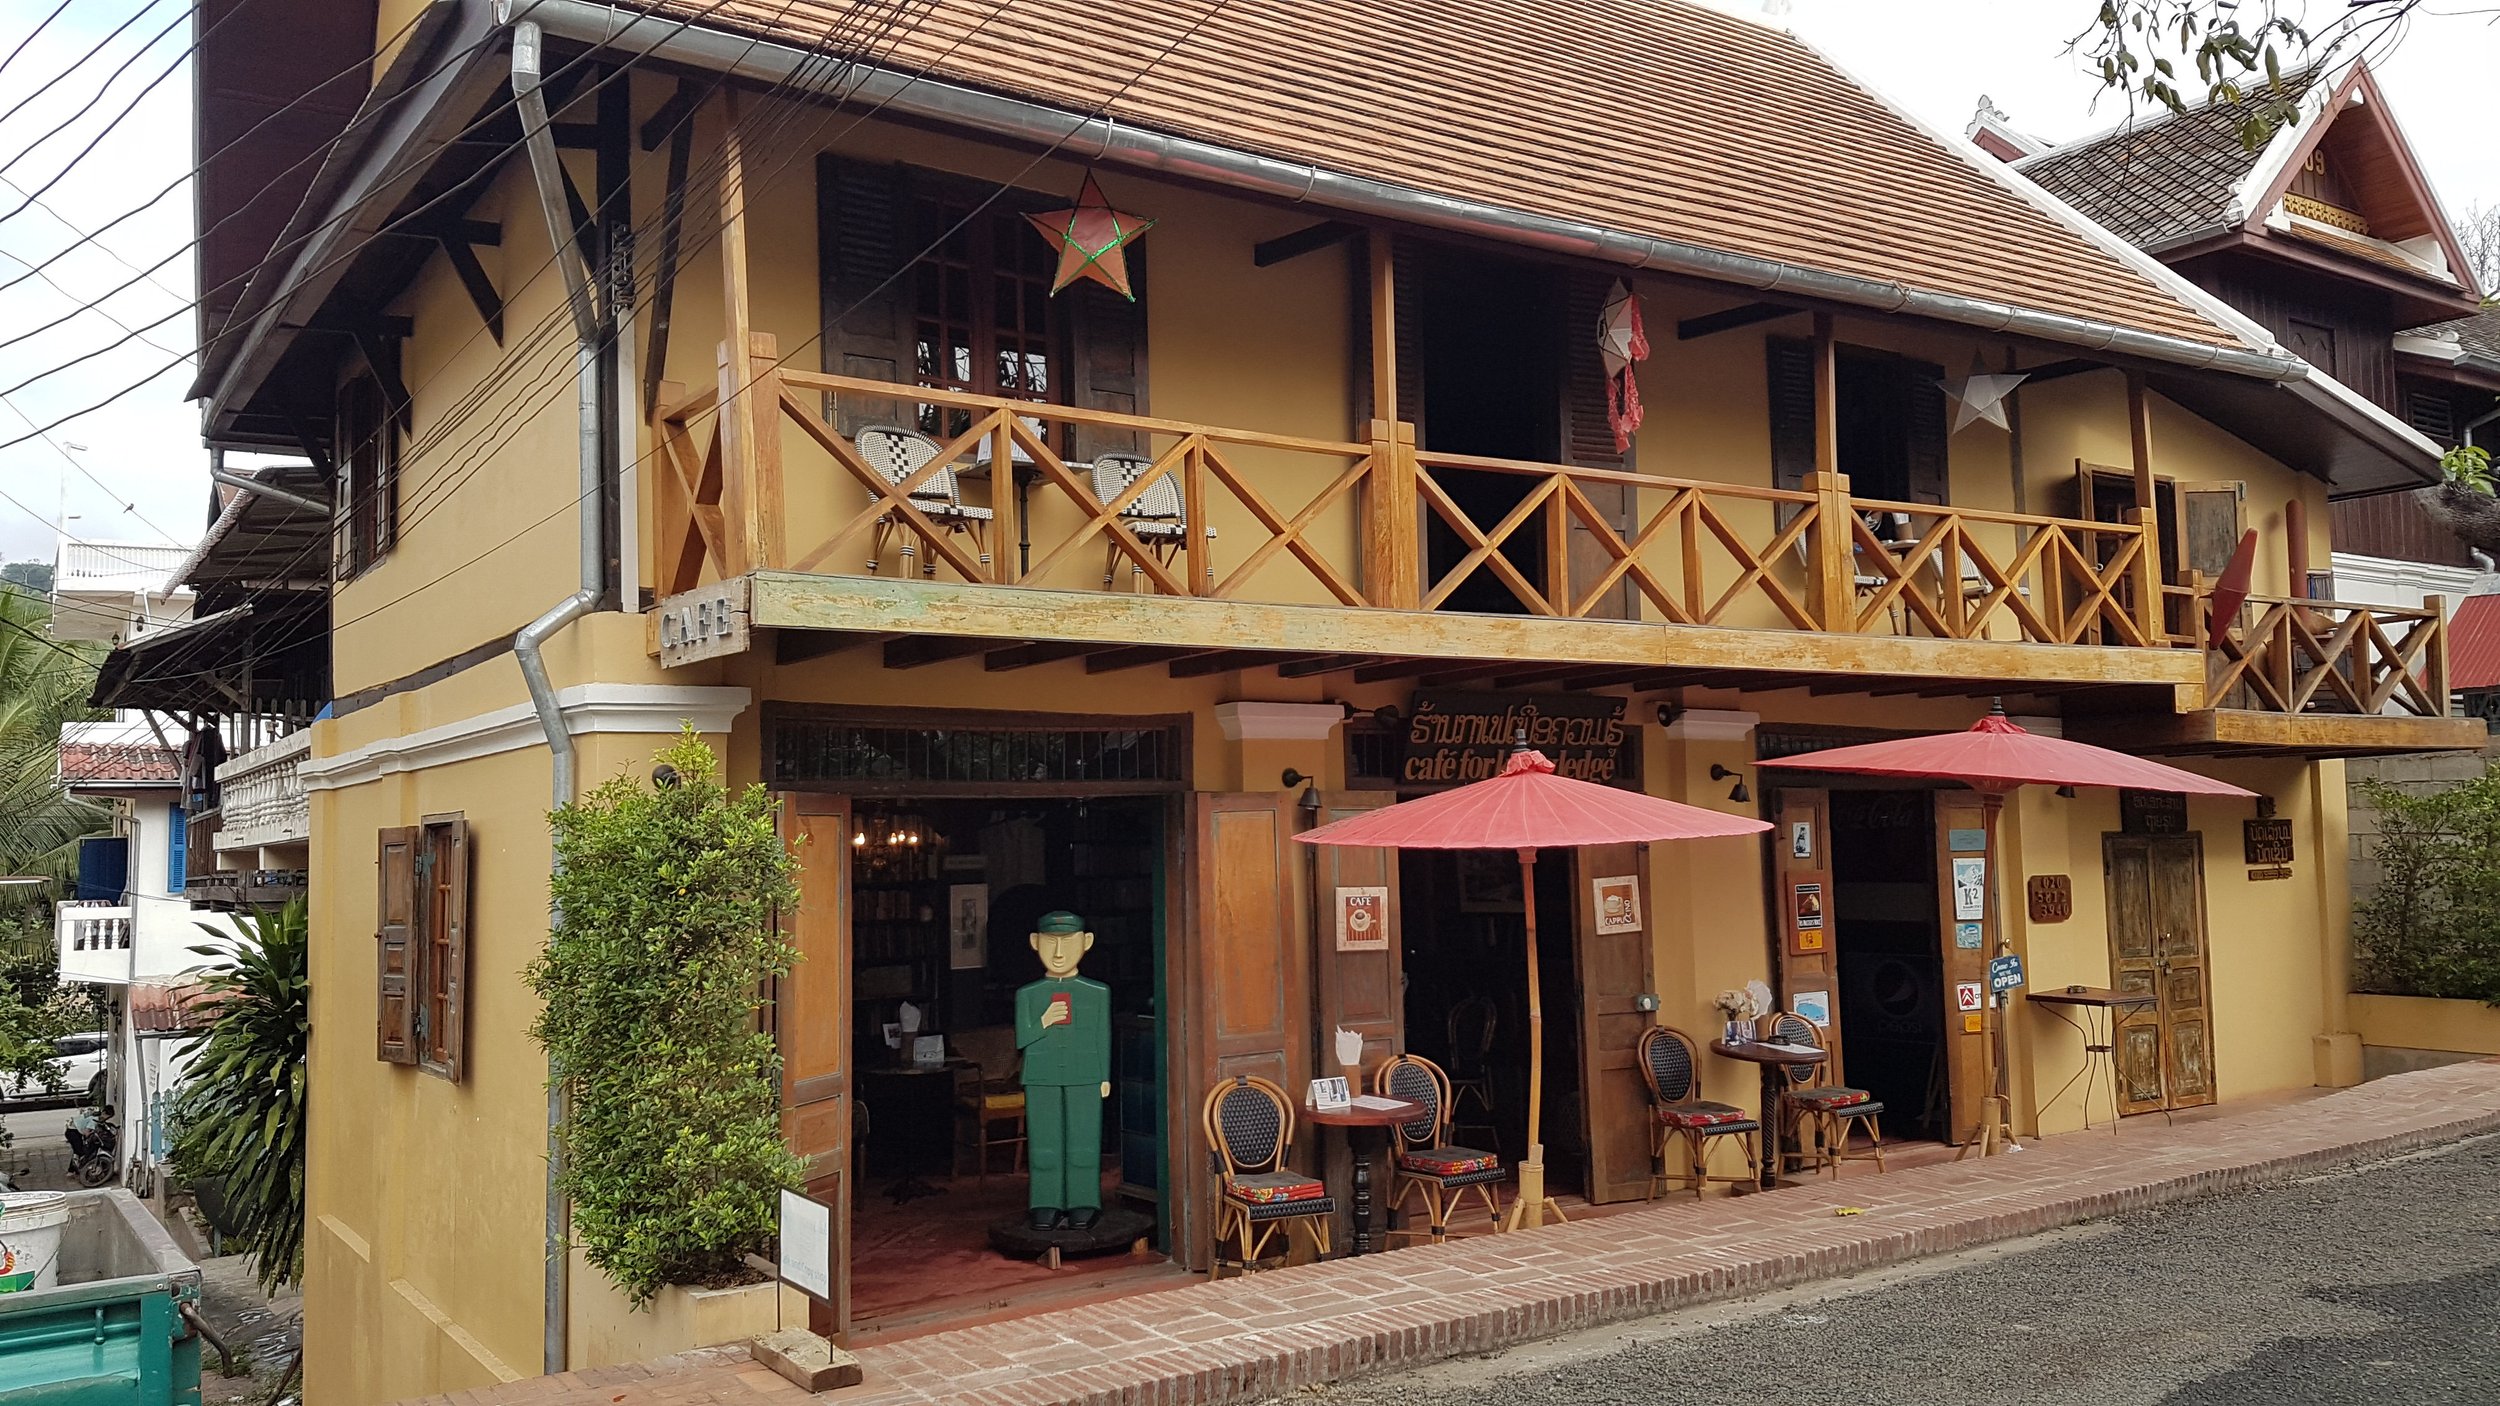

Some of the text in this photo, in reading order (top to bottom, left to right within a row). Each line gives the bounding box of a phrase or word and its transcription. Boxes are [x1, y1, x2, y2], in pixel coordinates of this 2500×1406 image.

[660, 597, 734, 648] CAFE
[1405, 748, 1458, 781] café
[1458, 748, 1495, 780] for
[1993, 973, 2022, 988] OPEN
